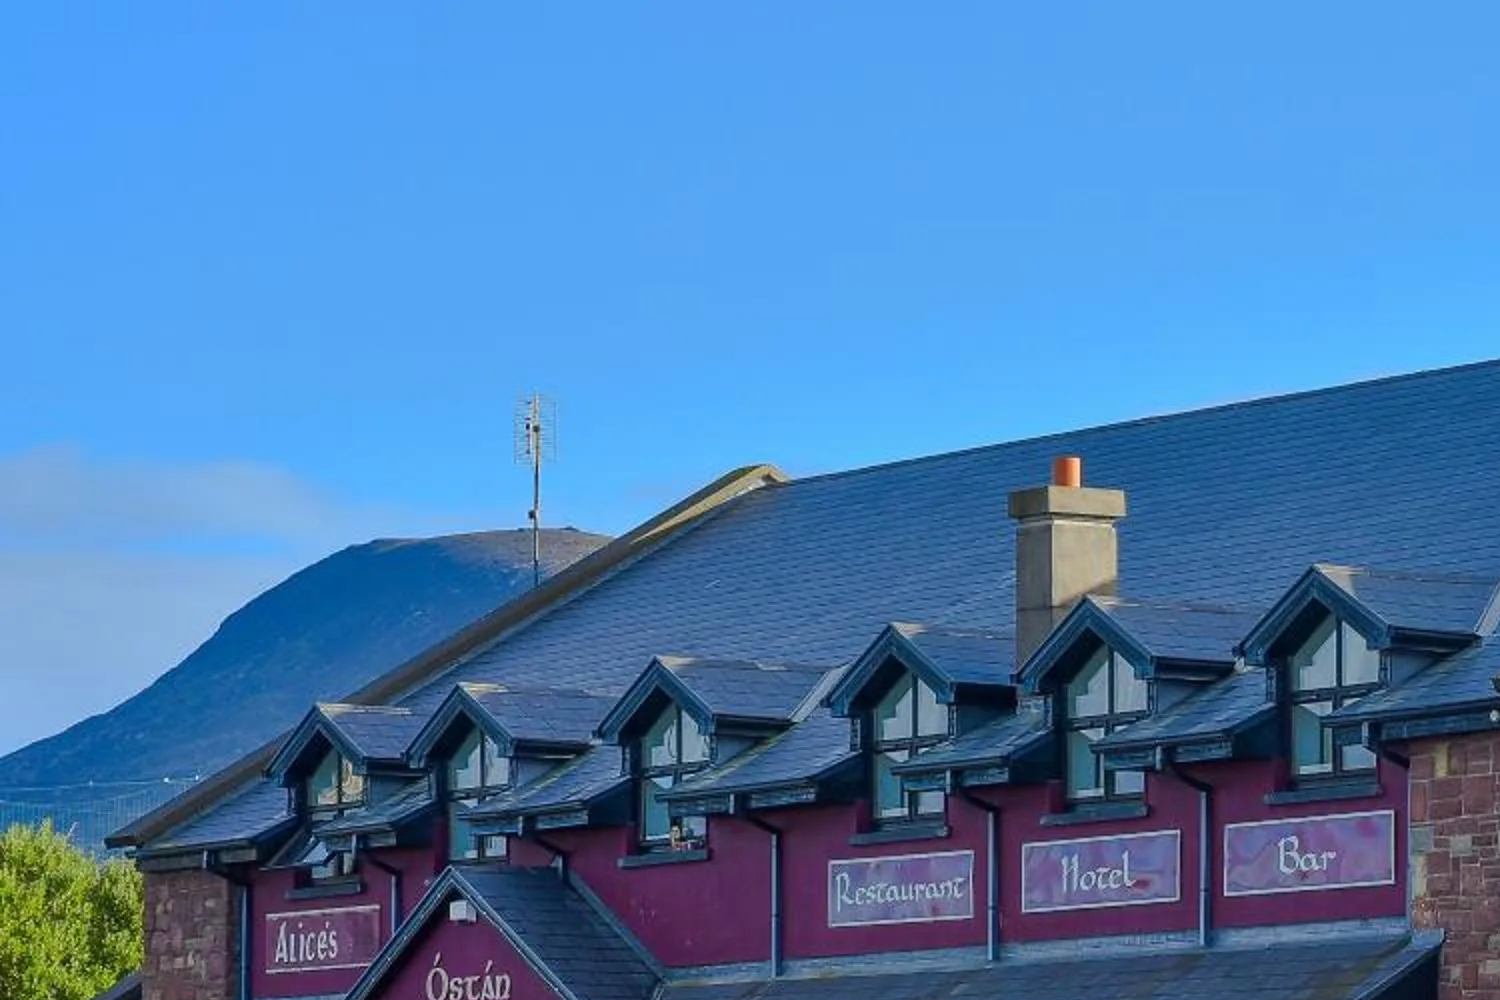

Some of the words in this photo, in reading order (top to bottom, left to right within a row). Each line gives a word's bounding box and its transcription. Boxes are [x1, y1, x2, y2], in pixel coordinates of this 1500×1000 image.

[1061, 850, 1136, 893] Hotel
[1278, 835, 1337, 874] Bar
[835, 871, 966, 913] Restaurant
